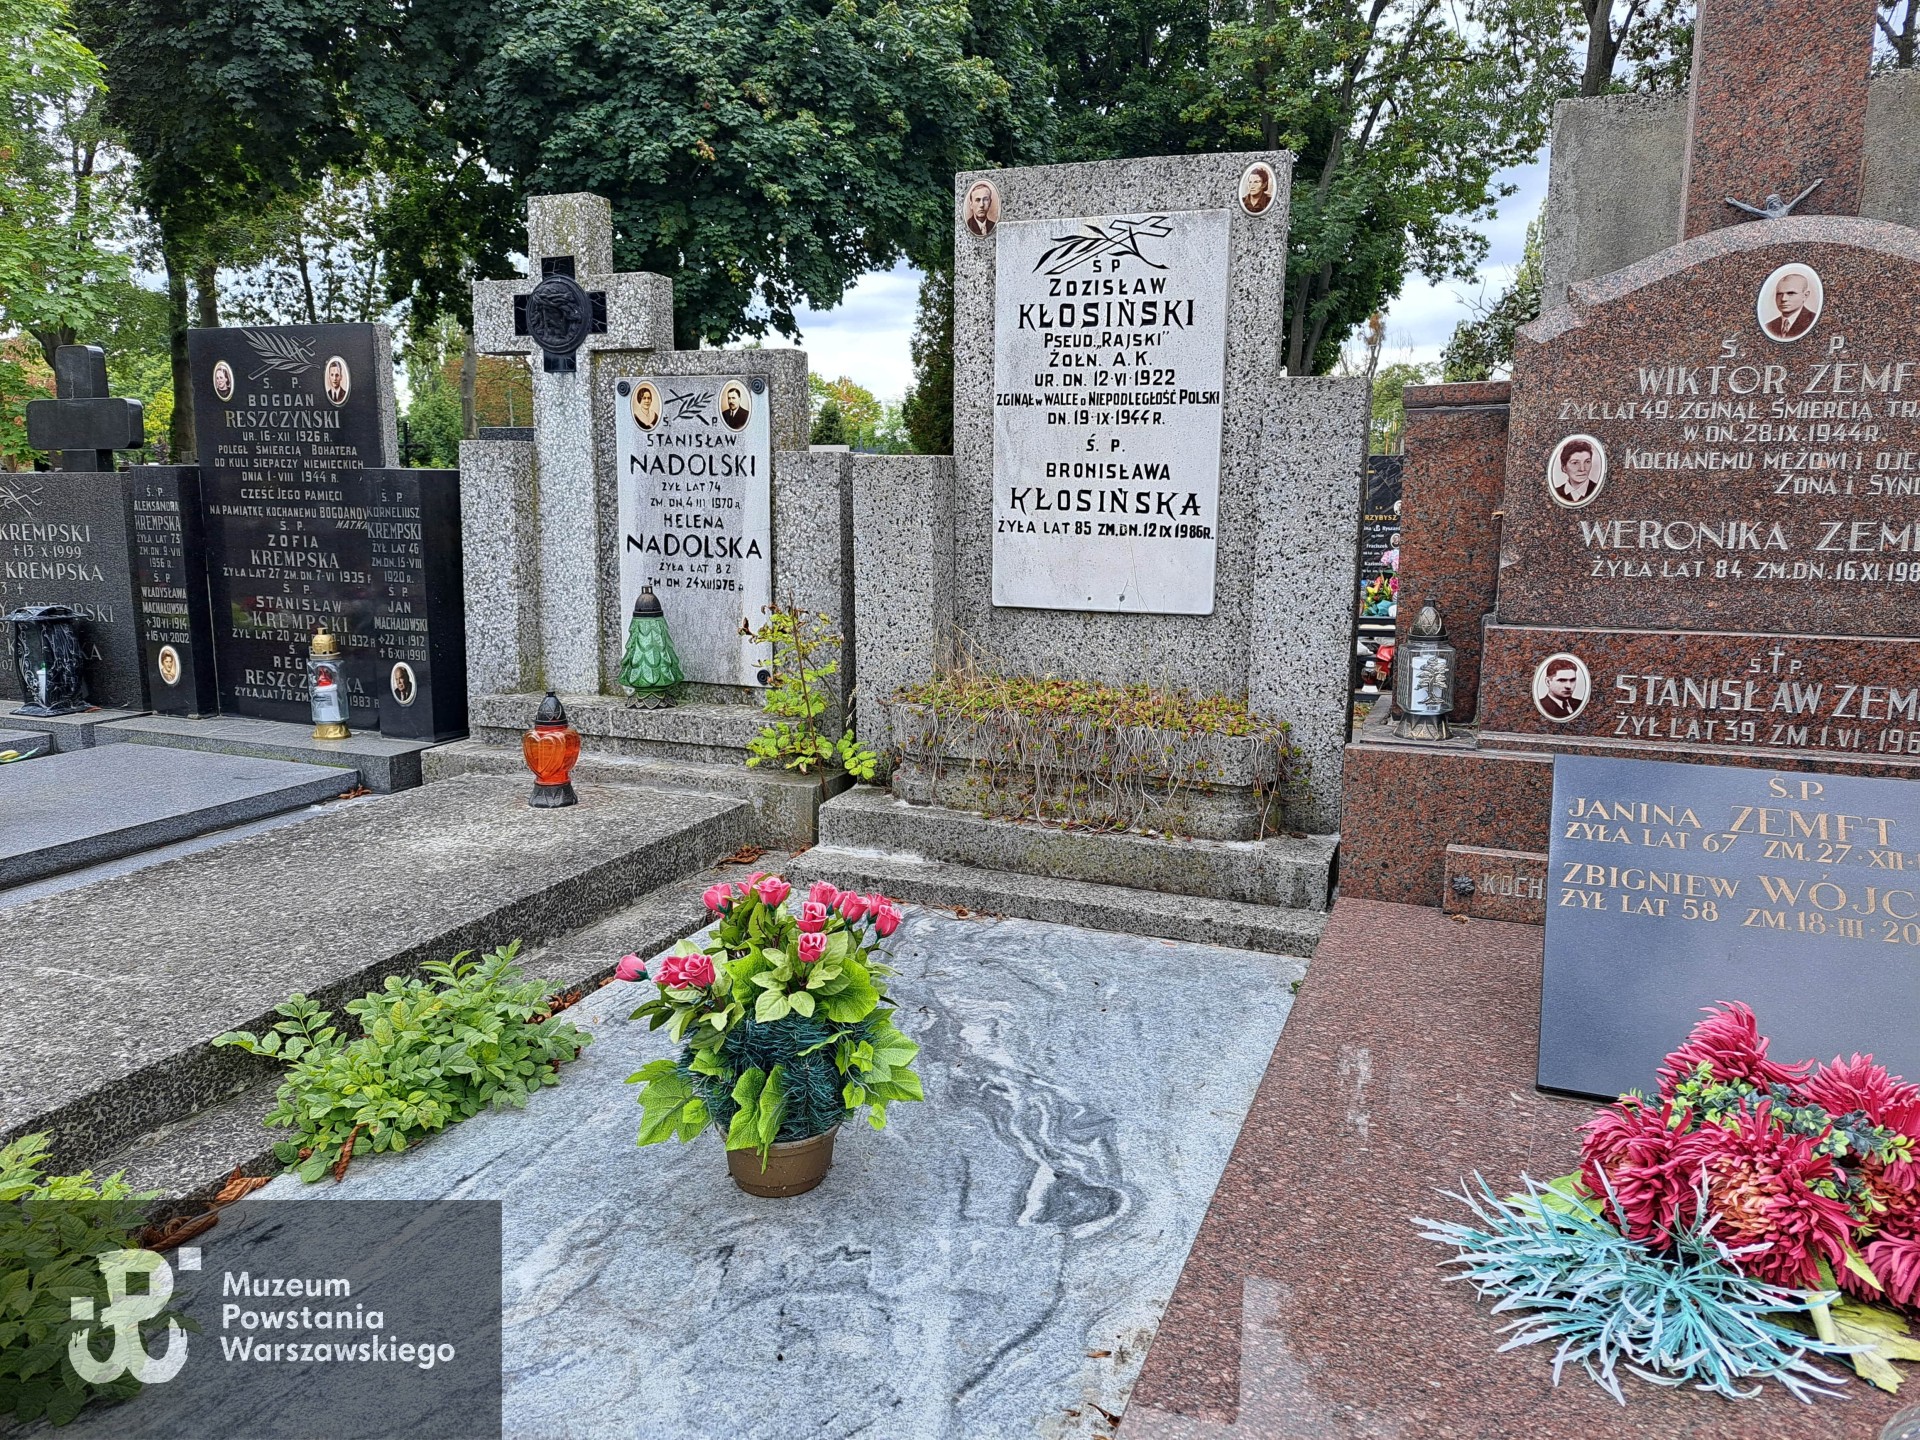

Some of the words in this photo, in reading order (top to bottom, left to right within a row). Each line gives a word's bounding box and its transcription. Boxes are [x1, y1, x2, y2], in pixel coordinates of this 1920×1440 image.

[1049, 277, 1167, 297] ZDZISŁAW
[1018, 298, 1196, 331] KŁOSIŃSKI
[1049, 350, 1102, 368] ŻOŁN.
[1638, 364, 1788, 396] WIKTOR
[248, 394, 315, 407] BOGDAN
[996, 393, 1035, 408] ZGINĄŁ
[1044, 392, 1078, 406] WALCE
[1088, 389, 1177, 406] NIEPODLEGŁOŚĆ
[1179, 389, 1220, 405] POLSKI
[224, 410, 341, 429] RESZCZYŃSKI
[1556, 398, 1601, 421] ŻYŁ
[1602, 402, 1638, 421] LAT
[1679, 401, 1761, 424] ZGINĄŁ
[296, 430, 321, 442] 1926
[647, 433, 737, 448] STANISŁAW
[1086, 433, 1099, 452] Ś.
[1110, 439, 1125, 452] P.
[1683, 426, 1698, 442] W
[218, 444, 249, 455] POLEGŁ
[256, 442, 302, 457] ŚMIERCIĄ
[214, 457, 225, 467] OD
[229, 458, 249, 468] KULI
[253, 458, 299, 469] SIEPACZY
[303, 459, 364, 470] NIEMIECKICH
[630, 453, 756, 477] NADOLSKI
[1624, 448, 1753, 471] KOCHANEMU
[241, 471, 263, 482] DNIA
[301, 471, 327, 483] 1944
[1046, 462, 1171, 481] BRONISŁAWA
[686, 482, 705, 492] LAT
[709, 481, 721, 492] 74
[1774, 469, 1837, 496] ŻONA
[240, 485, 275, 500] CZEŚĆ
[277, 488, 301, 500] JEGO
[304, 490, 343, 503] PAMIĘCI
[134, 500, 180, 512] ALEKSANDRA
[209, 504, 221, 515] NA
[222, 505, 264, 518] PAMIĄTKĘ
[266, 506, 317, 519] KOCHANEMU
[366, 506, 421, 519] KORNELIUSZ
[1010, 487, 1201, 521] KŁOSIŃSKA
[134, 515, 182, 532] KREMPSKA
[367, 521, 422, 540] KREMPSKI
[663, 513, 724, 530] HELENA
[998, 516, 1036, 534] ŻYŁA
[1044, 522, 1070, 534] LAT
[1075, 521, 1092, 535] 85
[0, 523, 91, 543] KREMPSKI
[155, 535, 167, 544] LAT
[267, 534, 319, 549] ZOFIA
[1579, 519, 1789, 552] WERONIKA
[372, 540, 387, 553] ŻYŁ
[391, 543, 406, 554] LAT
[408, 543, 419, 554] 46
[626, 533, 763, 560] NADOLSKA
[250, 549, 341, 569] KREMPSKA
[658, 558, 684, 571] ŻYŁA
[690, 564, 709, 573] LAT
[1591, 554, 1653, 579] ŻYŁA
[1663, 561, 1705, 578] LAT
[1715, 560, 1743, 579] 84
[5, 560, 105, 581] KREMPSKA
[223, 563, 247, 577] ŻYŁA
[249, 568, 266, 579] LAT
[268, 568, 280, 579] 27
[339, 571, 365, 583] 1935
[141, 586, 187, 599] WŁADYSŁAWA
[256, 595, 342, 613] STANISŁAW
[388, 601, 411, 614] JAN
[252, 610, 349, 633] KREMPSKI
[374, 616, 428, 632] MACHAŁOWSKI
[232, 625, 250, 638] ŻYŁ
[255, 630, 273, 640] LAT
[276, 630, 290, 642] 20
[262, 689, 278, 699] LAT
[1615, 674, 1823, 715] STANISŁAW
[1831, 684, 1920, 722] ZEM
[1614, 712, 1663, 737] ŻYŁ
[1670, 717, 1719, 741] LAT
[1568, 797, 1703, 829] JANINA
[1729, 805, 1897, 847] ZEMFT
[1564, 821, 1633, 845] ŻYŁA
[1641, 828, 1691, 850] LAT
[1702, 833, 1739, 853] 67
[1562, 861, 1741, 899] ZBIGNIEW
[1558, 888, 1608, 911] ŻYŁ
[1620, 894, 1670, 917] LAT
[1681, 898, 1719, 922] 58
